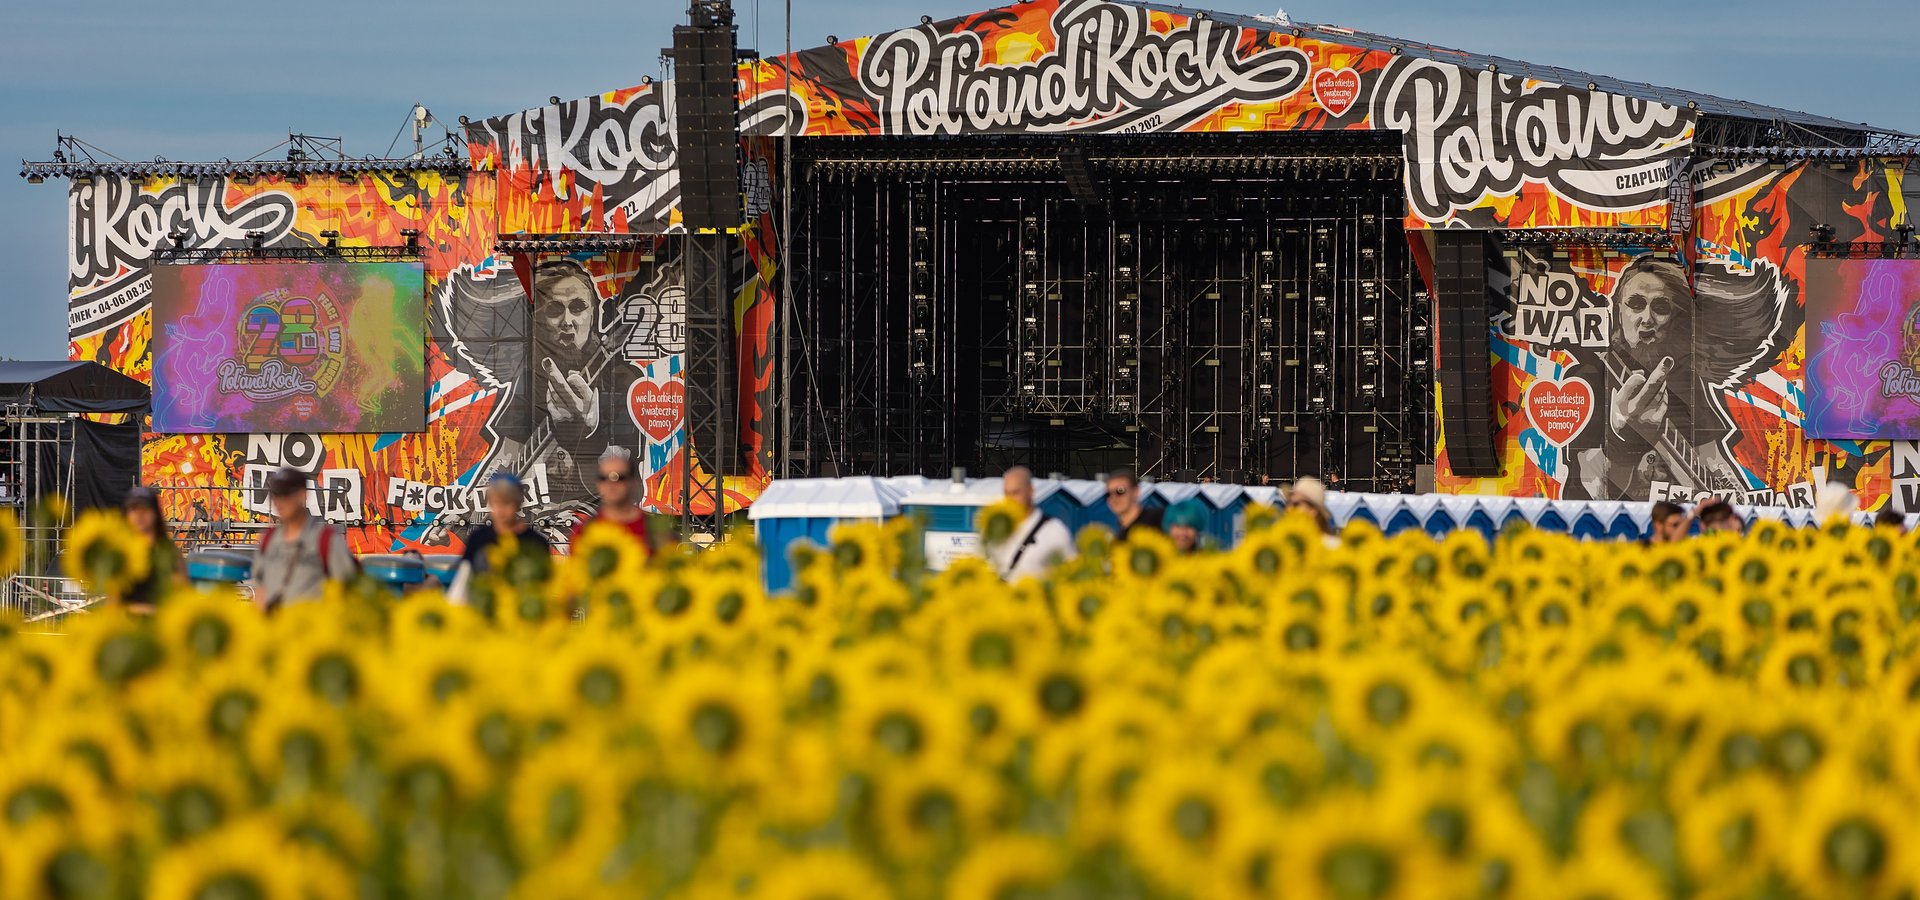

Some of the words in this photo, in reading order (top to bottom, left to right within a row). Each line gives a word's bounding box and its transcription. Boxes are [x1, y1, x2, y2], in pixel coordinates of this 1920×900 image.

[1328, 98, 1347, 107] pomocy
[1518, 273, 1574, 307] NO
[316, 292, 340, 321] PEACE
[1522, 308, 1605, 344] WAR
[328, 326, 341, 353] LOVE
[635, 390, 656, 403] wielka
[1533, 391, 1556, 405] wielka
[1557, 392, 1585, 405] orkiestra
[1540, 406, 1580, 423] świątecznej
[648, 419, 672, 431] pomocy
[1548, 421, 1574, 433] pomocy
[246, 432, 316, 467] NO
